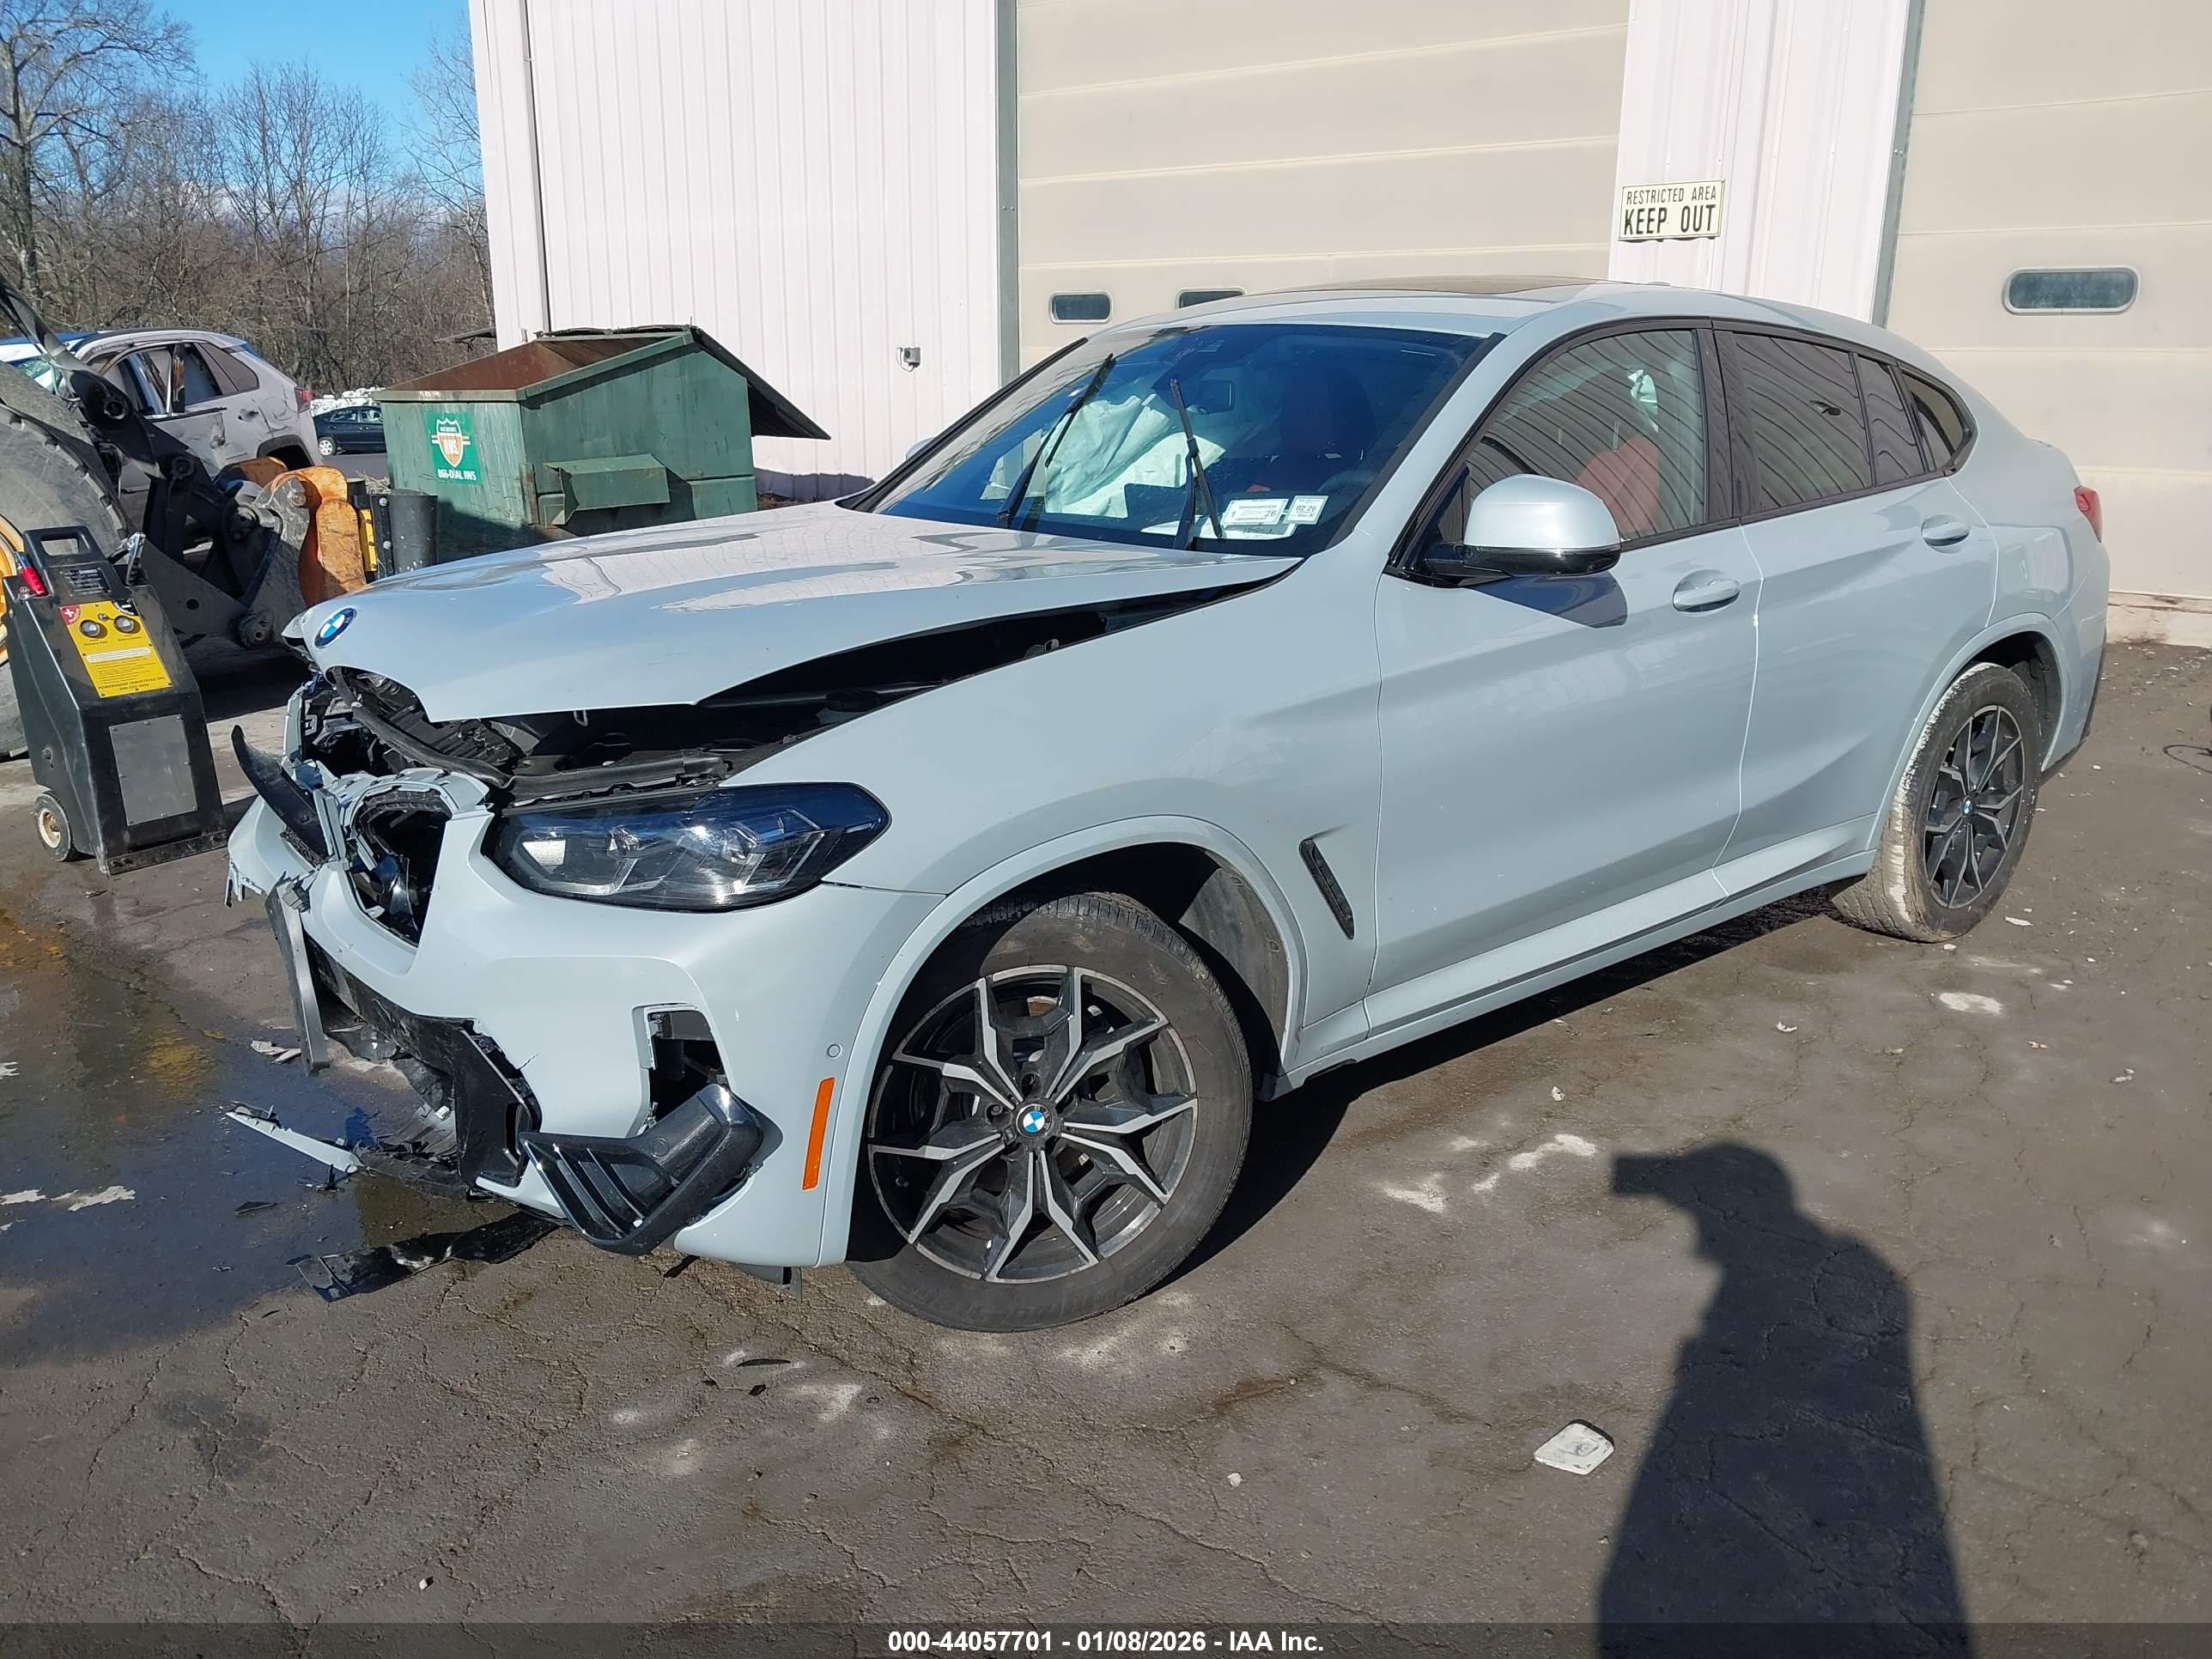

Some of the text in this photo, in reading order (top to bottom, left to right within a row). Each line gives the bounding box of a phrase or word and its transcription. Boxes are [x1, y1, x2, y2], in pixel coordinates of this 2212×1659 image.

[1626, 185, 1717, 205] RESTRICTED AREA
[1624, 204, 1717, 234] KEEP OUT
